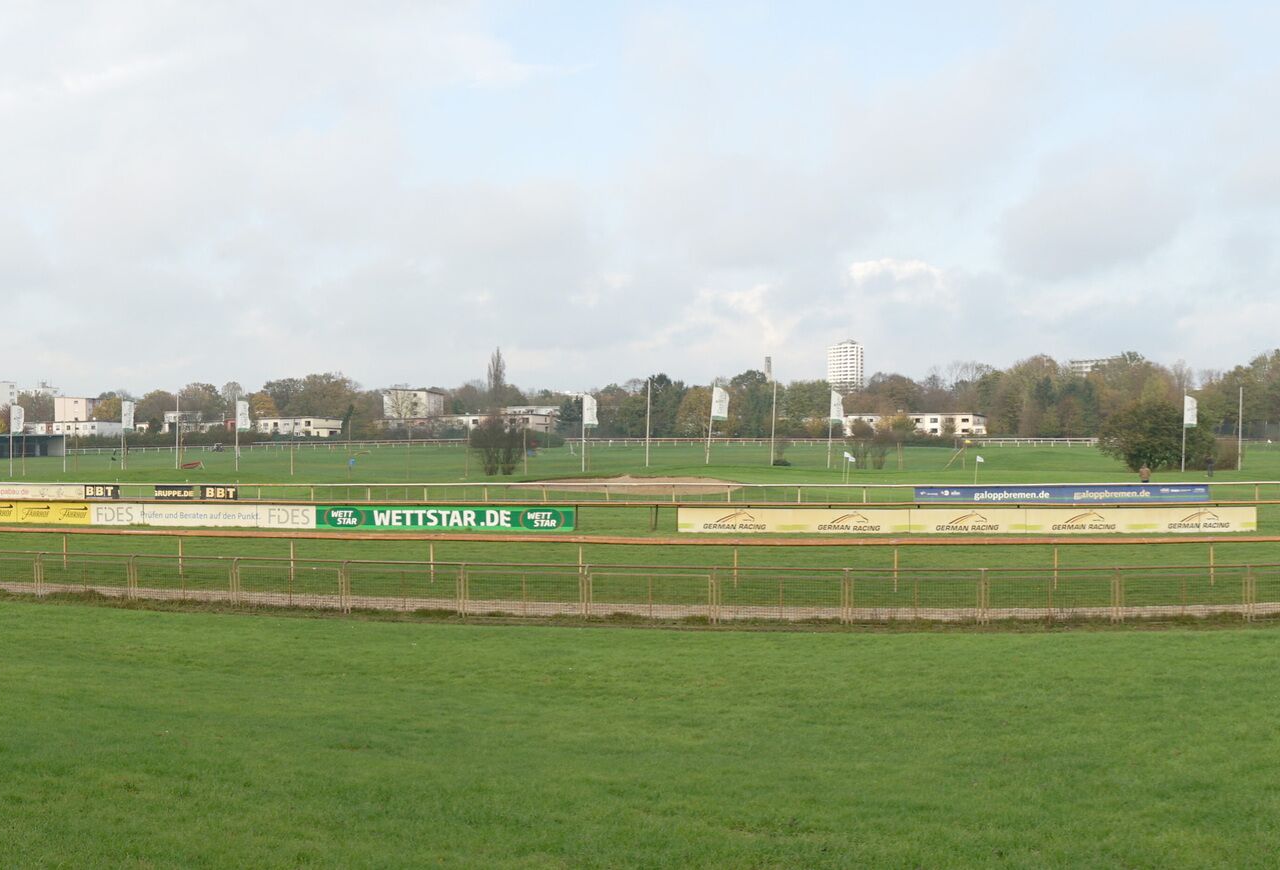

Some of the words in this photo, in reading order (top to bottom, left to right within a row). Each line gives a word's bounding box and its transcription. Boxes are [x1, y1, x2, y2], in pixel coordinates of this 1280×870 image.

[86, 486, 114, 497] BBT
[205, 487, 236, 499] BBT
[973, 490, 1050, 501] galoppbremen.de
[1073, 490, 1151, 500] galoppbremen.de
[140, 510, 163, 520] Prüfen
[165, 510, 177, 519] und
[179, 511, 208, 520] Beraten
[209, 511, 223, 520] auf
[225, 511, 236, 520] den
[331, 510, 353, 518] WETT
[527, 512, 552, 521] WETT
[336, 517, 358, 525] STAR
[533, 520, 557, 529] STAR
[739, 523, 766, 531] RACING
[853, 525, 880, 533] RACING
[1202, 522, 1230, 530] RACING
